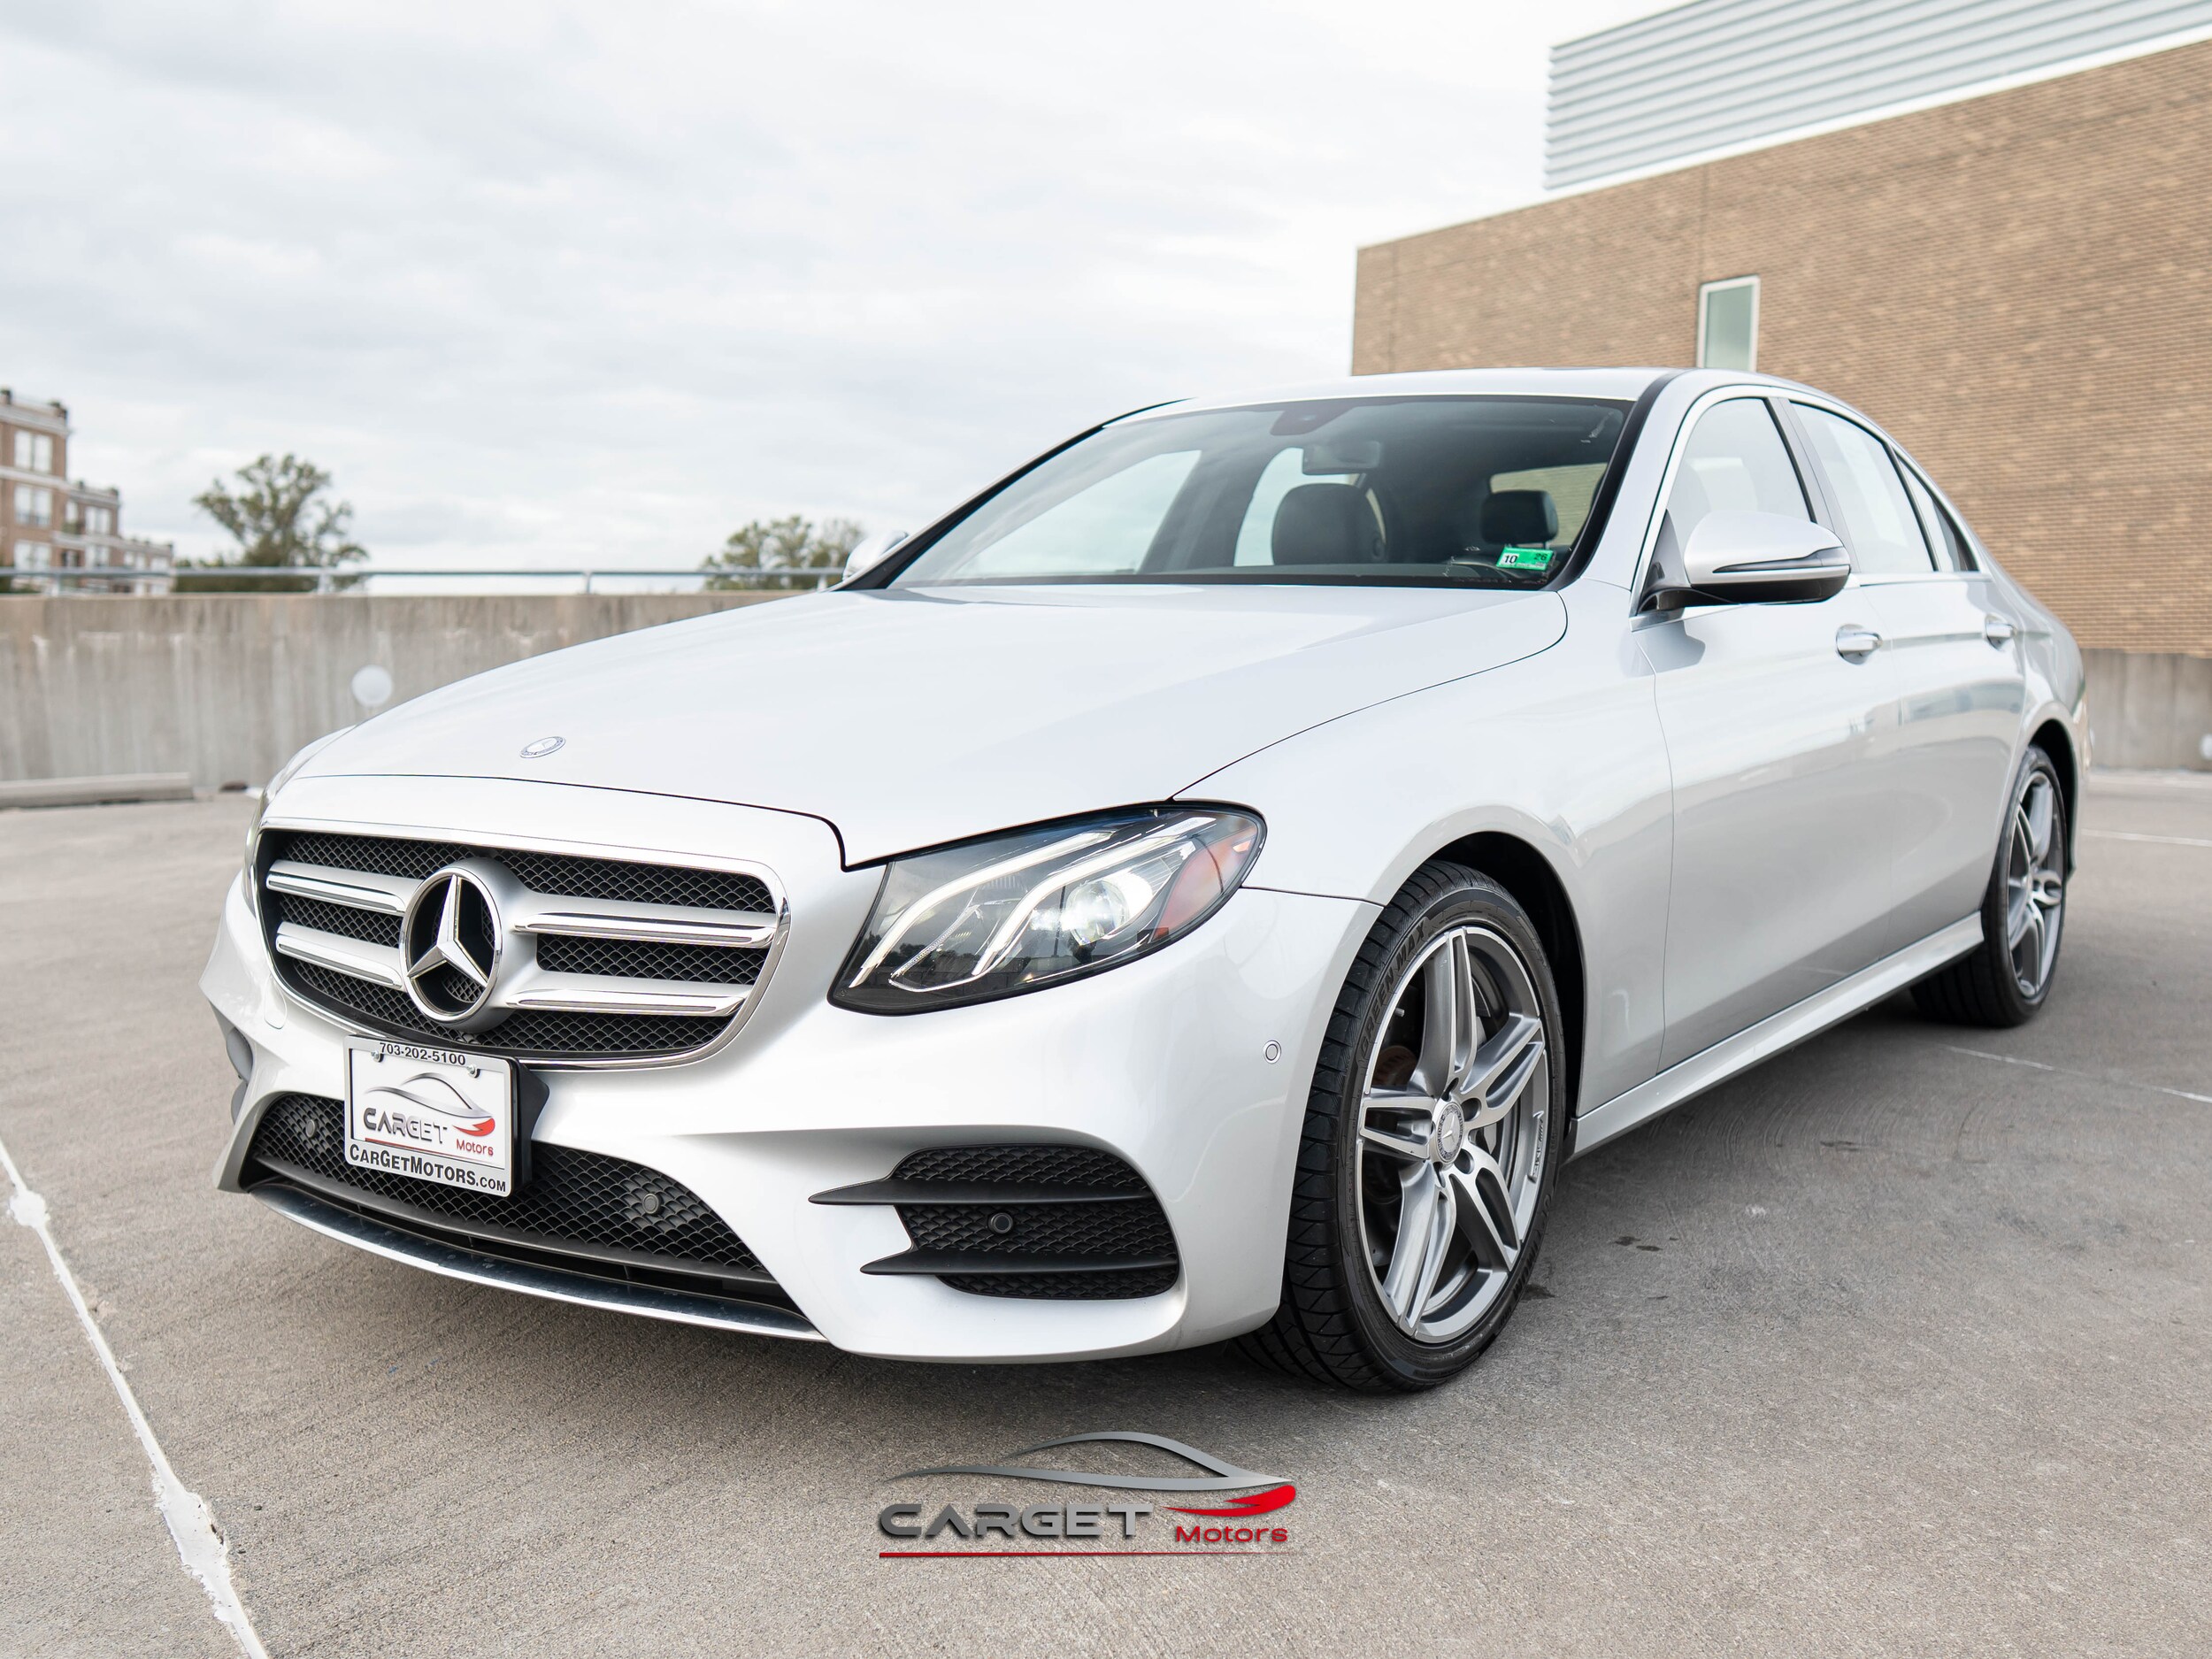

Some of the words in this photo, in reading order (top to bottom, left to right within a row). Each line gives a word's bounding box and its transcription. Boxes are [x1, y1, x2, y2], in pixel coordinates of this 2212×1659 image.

[1504, 555, 1518, 564] 10
[1396, 919, 1425, 971] MAX
[380, 1042, 466, 1065] 703-202-5100
[363, 1107, 448, 1143] CARGET
[456, 1139, 494, 1156] Motors
